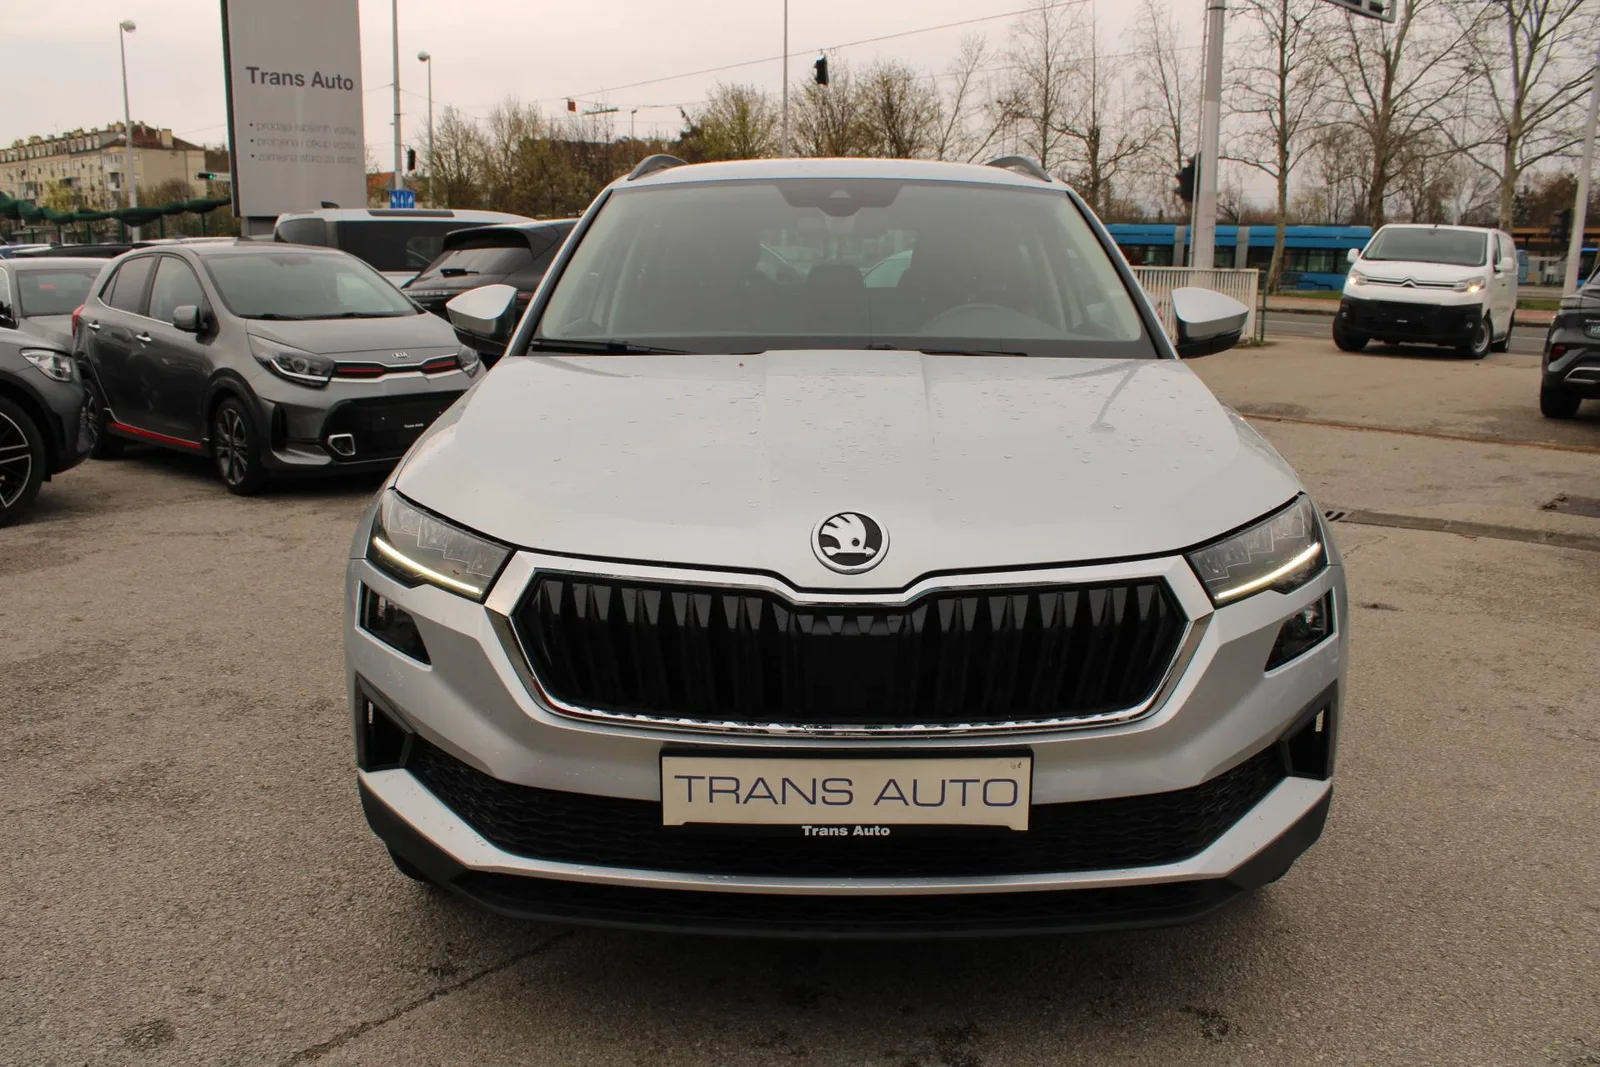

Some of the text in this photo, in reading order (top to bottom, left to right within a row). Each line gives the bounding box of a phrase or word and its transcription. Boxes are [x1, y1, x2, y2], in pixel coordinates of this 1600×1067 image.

[245, 66, 354, 91] Trans Auto
[674, 775, 1019, 808] TRANS AUTO
[801, 825, 891, 836] Trans Auto
